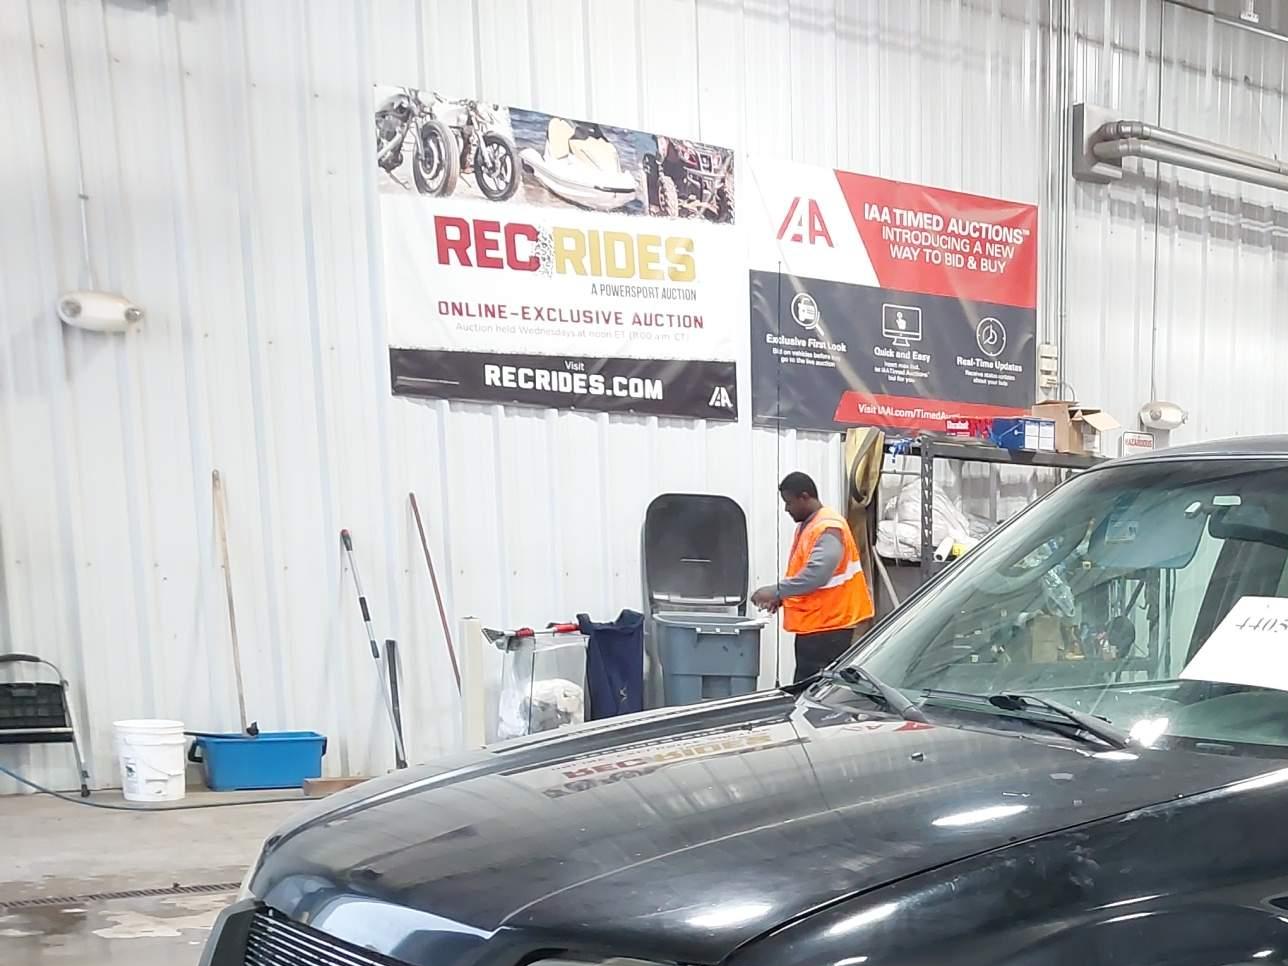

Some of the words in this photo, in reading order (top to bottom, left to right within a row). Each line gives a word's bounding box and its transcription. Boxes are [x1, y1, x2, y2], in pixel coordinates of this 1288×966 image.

[864, 203, 891, 223] IAA
[893, 208, 944, 232] TIMED
[434, 215, 541, 272] REC
[552, 226, 696, 282] RIDES
[882, 226, 970, 253] INTRODUCING
[973, 242, 983, 255] A
[985, 243, 1015, 259] NEW
[890, 244, 920, 261] WAY
[923, 249, 942, 264] TO
[945, 253, 964, 268] BID
[967, 256, 977, 270] &
[981, 258, 1007, 274] BUY
[591, 283, 598, 295] A
[600, 284, 659, 299] POWERSPORT
[661, 287, 697, 301] AUCTION
[438, 301, 623, 325] ONLINE-EXCLUSIVE
[632, 312, 704, 329] AUCTION
[456, 322, 493, 334] Auction
[766, 333, 806, 347] Exclusive
[874, 346, 894, 358] Quick
[896, 350, 910, 359] and
[913, 351, 930, 362] Easy
[565, 359, 585, 372] Visit
[957, 356, 993, 369] Real-Time
[995, 361, 1023, 373] Updates
[484, 364, 663, 401] RECRIDES.COM
[858, 403, 876, 415] Visit
